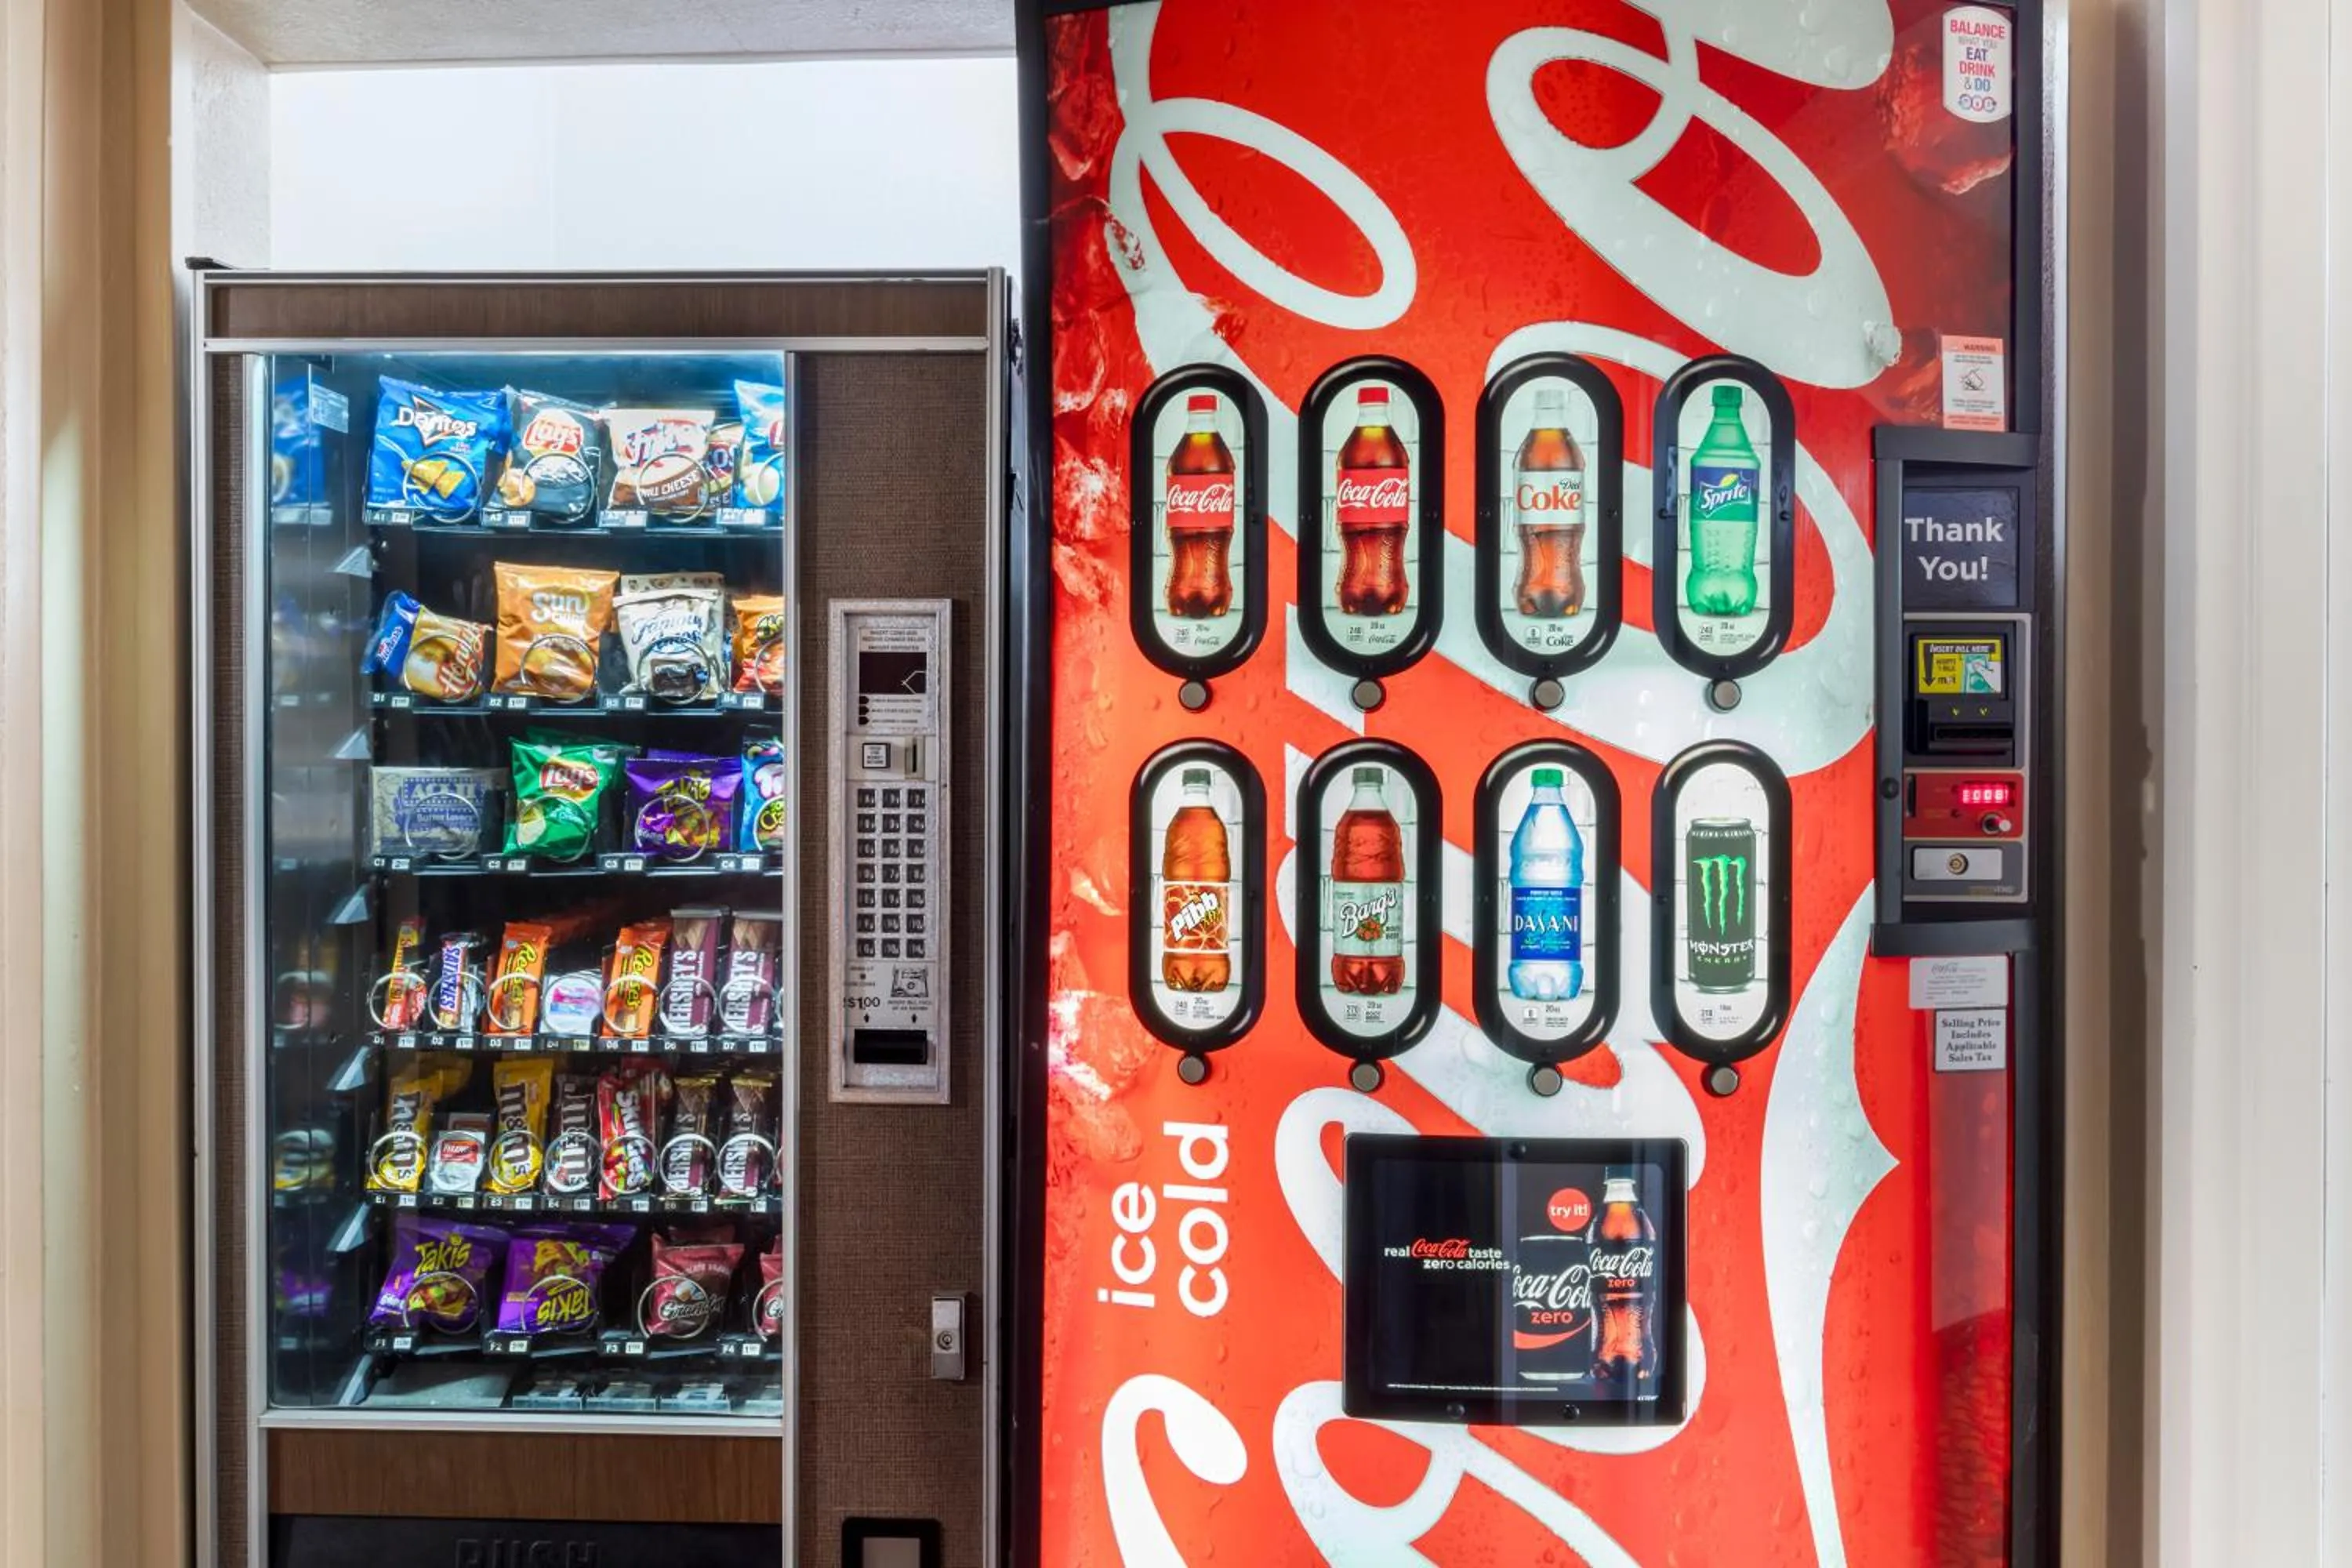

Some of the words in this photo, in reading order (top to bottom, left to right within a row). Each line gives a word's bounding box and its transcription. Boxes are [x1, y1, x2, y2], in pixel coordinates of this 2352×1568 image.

[1950, 19, 2005, 38] BALANCE
[1966, 46, 1988, 61] EAT
[1959, 61, 1995, 78] DRINK
[1974, 78, 1991, 93] DO
[397, 406, 477, 437] Doritos
[1167, 483, 1234, 514] Coca-Cola
[1337, 477, 1408, 509] Coca-Cola
[1516, 483, 1582, 511] Coke
[1700, 482, 1748, 510] Sprite
[1904, 517, 2004, 543] Thank
[1918, 556, 1989, 581] You!
[531, 591, 590, 624] Sun
[1929, 643, 1954, 653] INSERT
[1171, 891, 1218, 941] Pibb
[1339, 887, 1397, 938] Barq's
[1515, 909, 1578, 935] DASANI
[1690, 939, 1754, 956] MONSTER
[1942, 1018, 1975, 1028] Selling
[1978, 1017, 2001, 1027] Price
[1951, 1030, 1991, 1040] Includes
[1946, 1041, 1997, 1051] Applicable
[1948, 1054, 1973, 1063] Sales
[1975, 1052, 1992, 1062] Tax
[1163, 1121, 1229, 1317] cold
[1549, 1204, 1570, 1218] try
[1573, 1204, 1588, 1214] it!
[413, 1233, 473, 1279] Takis
[1097, 1182, 1156, 1308] ice
[1384, 1245, 1410, 1257] real
[1411, 1238, 1472, 1258] Coca-Cola
[1468, 1247, 1502, 1258] taste
[1423, 1259, 1455, 1269] zero
[1457, 1258, 1511, 1269] calories
[1589, 1247, 1655, 1279] Coca-Cola
[1608, 1279, 1635, 1288] zero
[536, 1288, 593, 1326] Takis
[1530, 1310, 1573, 1324] zero
